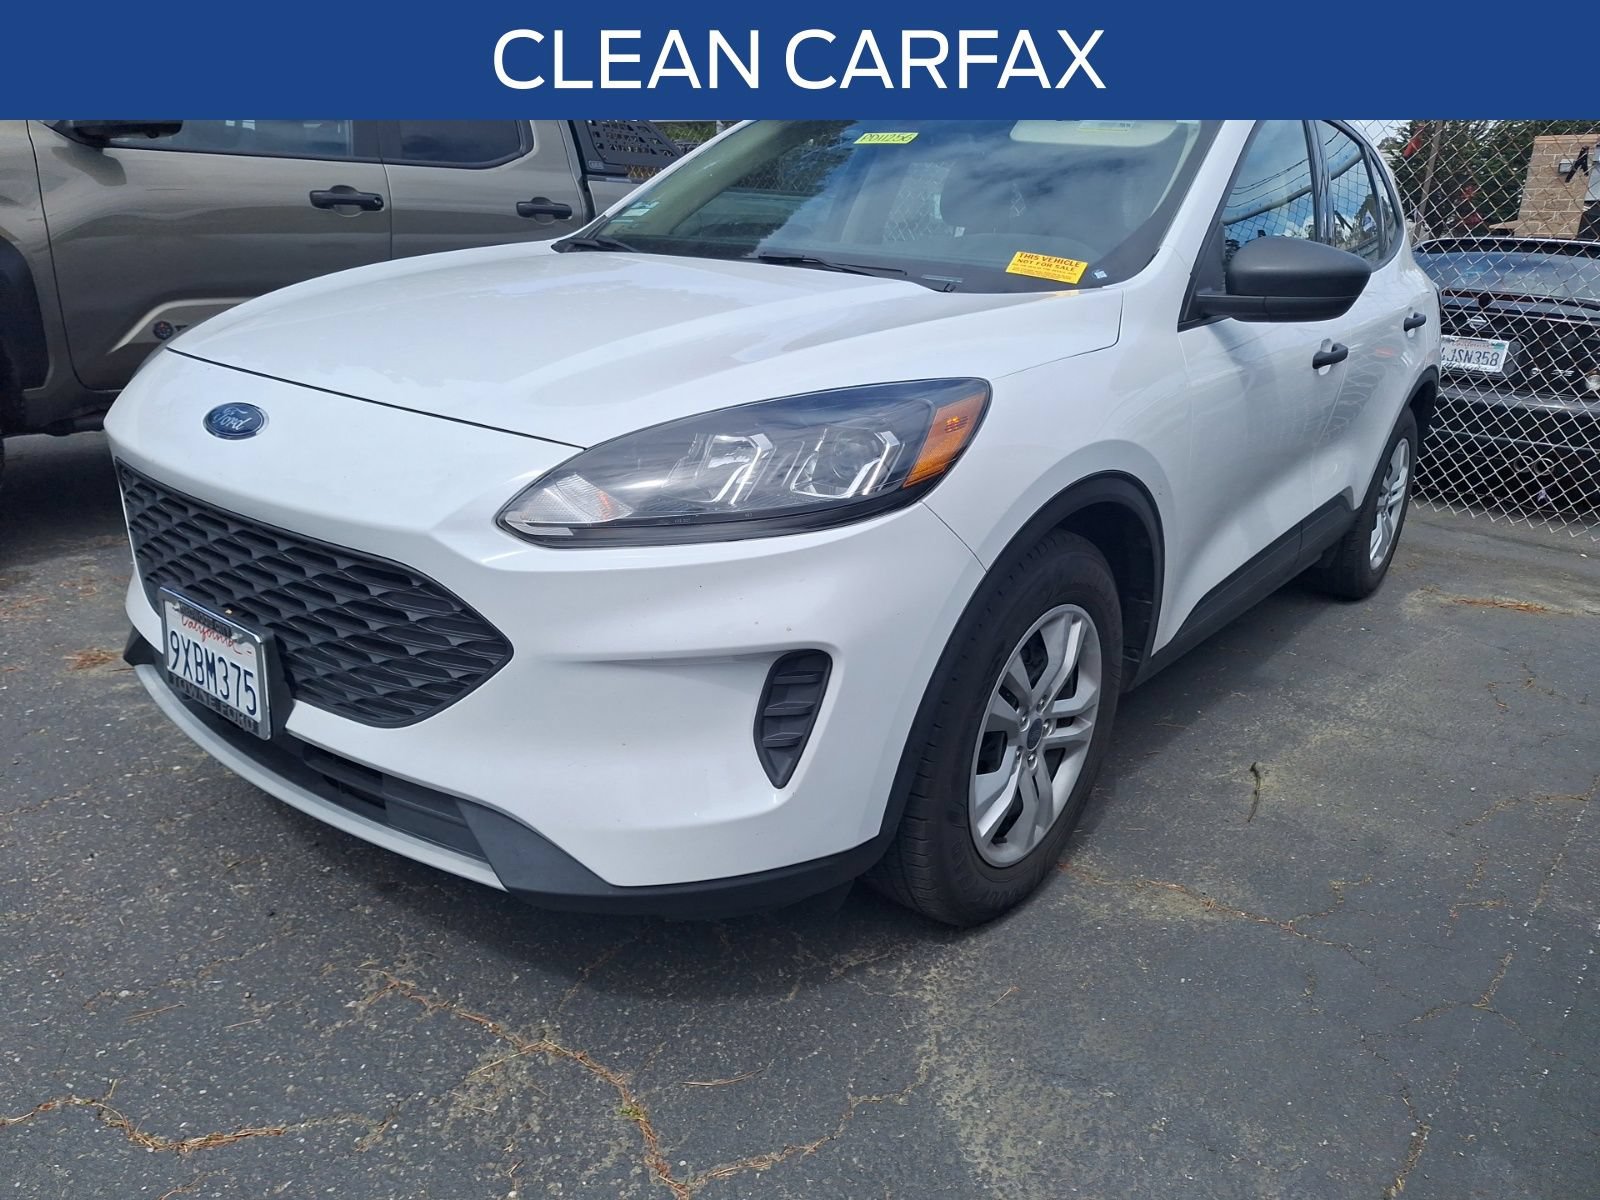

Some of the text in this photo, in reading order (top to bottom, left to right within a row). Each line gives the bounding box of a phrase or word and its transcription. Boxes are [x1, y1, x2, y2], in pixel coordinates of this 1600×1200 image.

[1019, 253, 1080, 267] THIS VEHICLE
[1055, 264, 1075, 272] SALE
[212, 407, 253, 431] Ford
[170, 630, 257, 716] 9XBM375
